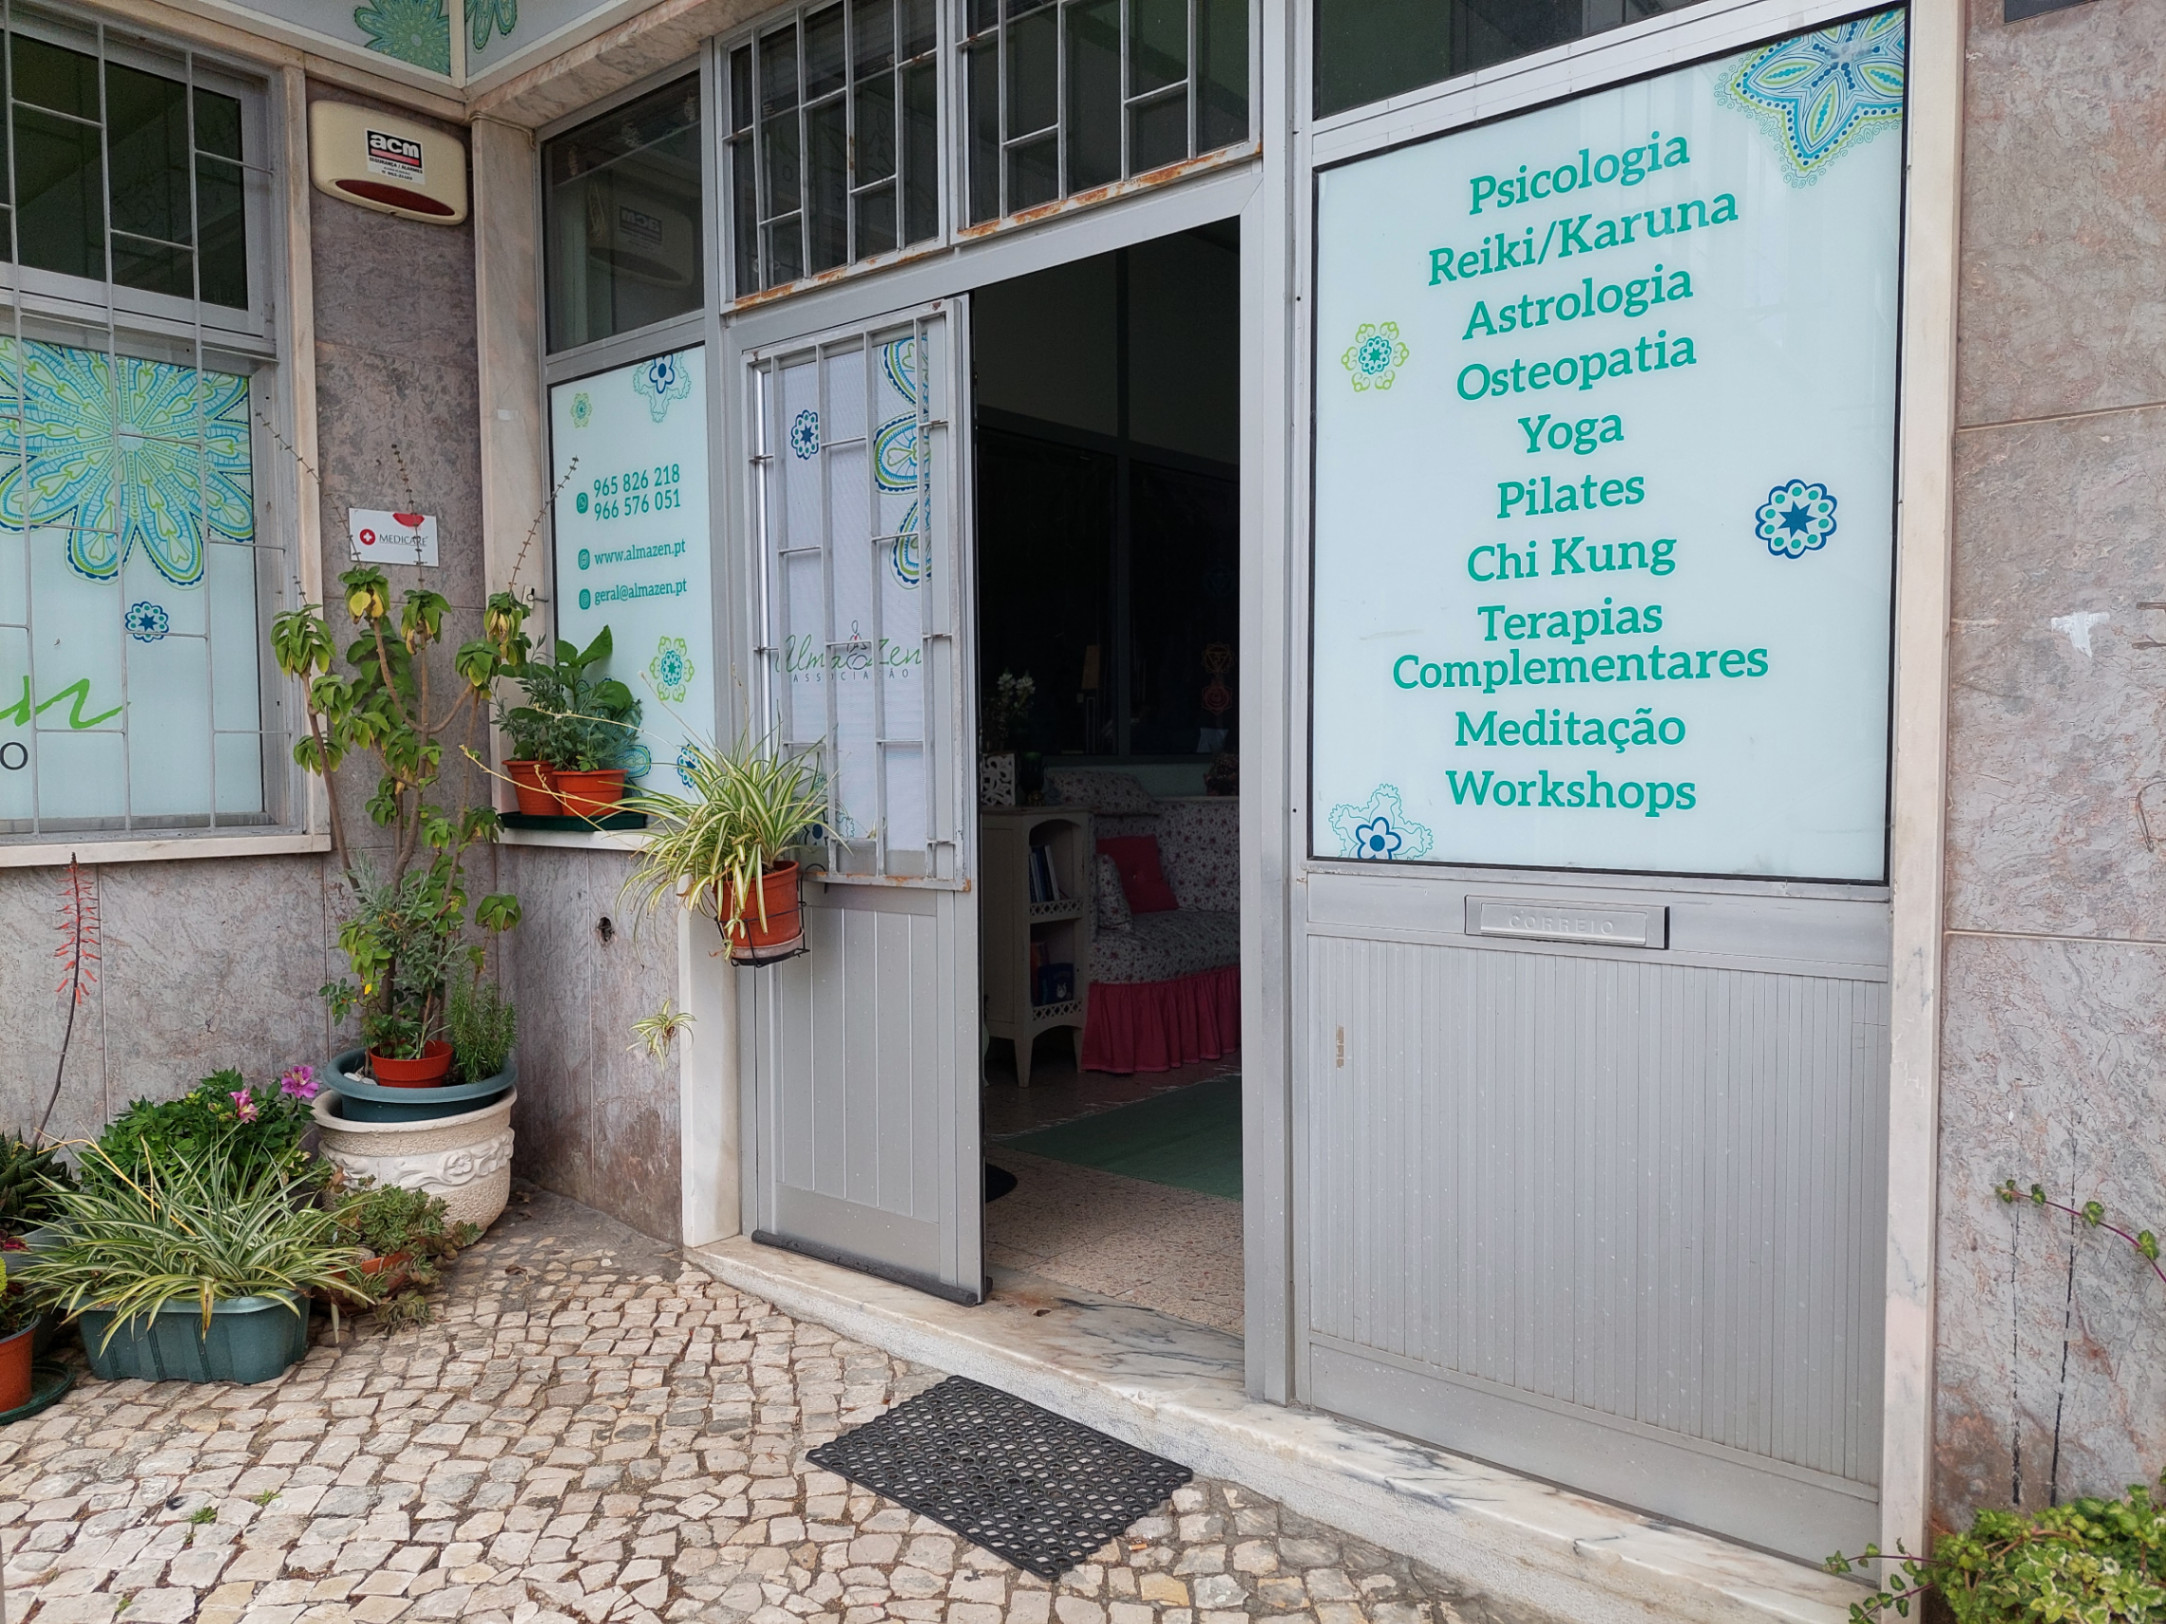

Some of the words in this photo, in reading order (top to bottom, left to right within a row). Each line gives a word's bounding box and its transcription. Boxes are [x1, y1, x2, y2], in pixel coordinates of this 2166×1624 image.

[370, 134, 420, 159] acm
[1468, 131, 1691, 215] Psicologia
[1428, 192, 1739, 286] Reiki/Karuna
[1462, 264, 1694, 340] Astrologia
[1456, 329, 1697, 401] Osteopatia
[1518, 413, 1624, 455] Yoga
[593, 476, 618, 498] 965
[622, 469, 649, 493] 826
[654, 463, 681, 487] 218
[1497, 474, 1646, 519] Pilates
[594, 499, 620, 521] 966
[624, 494, 650, 516] 576
[654, 488, 681, 511] 051
[594, 538, 686, 565] www.almazen.pt
[1467, 545, 1539, 582] Chi
[1551, 535, 1678, 576] Kung
[594, 578, 688, 606] geral@almazen.pt
[1477, 598, 1663, 645] Terapias
[793, 667, 909, 683] ASSCIAÃO
[1392, 644, 1769, 694] Complementares
[1455, 707, 1686, 753] Meditação
[1445, 770, 1697, 817] Workshops
[1508, 913, 1615, 935] CORREIO
